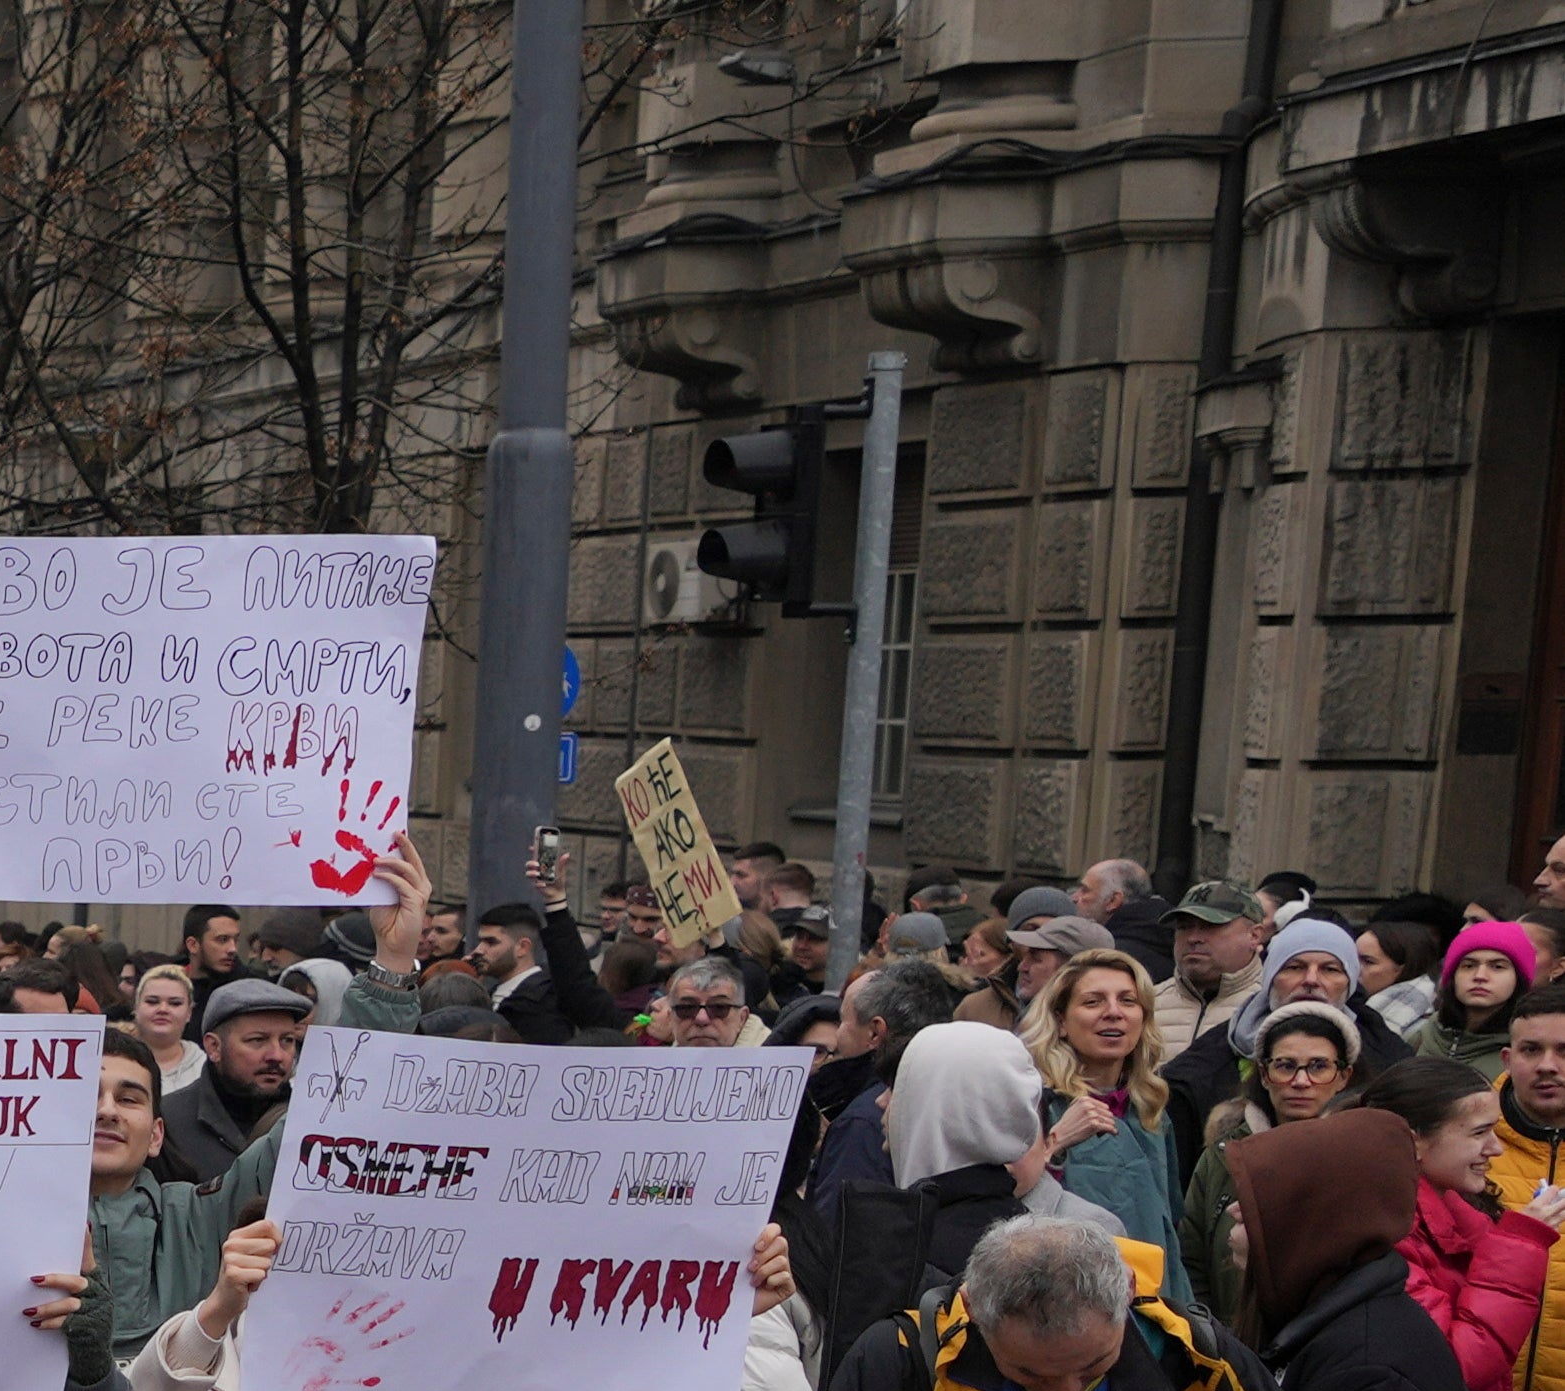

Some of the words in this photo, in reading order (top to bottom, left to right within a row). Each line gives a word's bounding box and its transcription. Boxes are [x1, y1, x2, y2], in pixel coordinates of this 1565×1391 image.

[101, 545, 211, 615] ЈЕ
[243, 545, 434, 612] ПИТАЊЕ
[160, 634, 199, 683] И
[217, 636, 412, 704] СМРТИ,
[47, 693, 200, 748] РЕКЕ
[225, 700, 360, 776] КРВИ
[195, 782, 304, 820] СТЕ
[42, 826, 242, 895] ПРВИ!
[653, 808, 696, 870] АКО
[292, 1133, 490, 1200] OSMEHE
[499, 1147, 600, 1204] KAD
[608, 1150, 706, 1205] NAM
[714, 1150, 780, 1205] JE
[271, 1212, 466, 1280] DRŽAVA
[487, 1257, 538, 1344] U
[549, 1257, 740, 1350] KVARU
